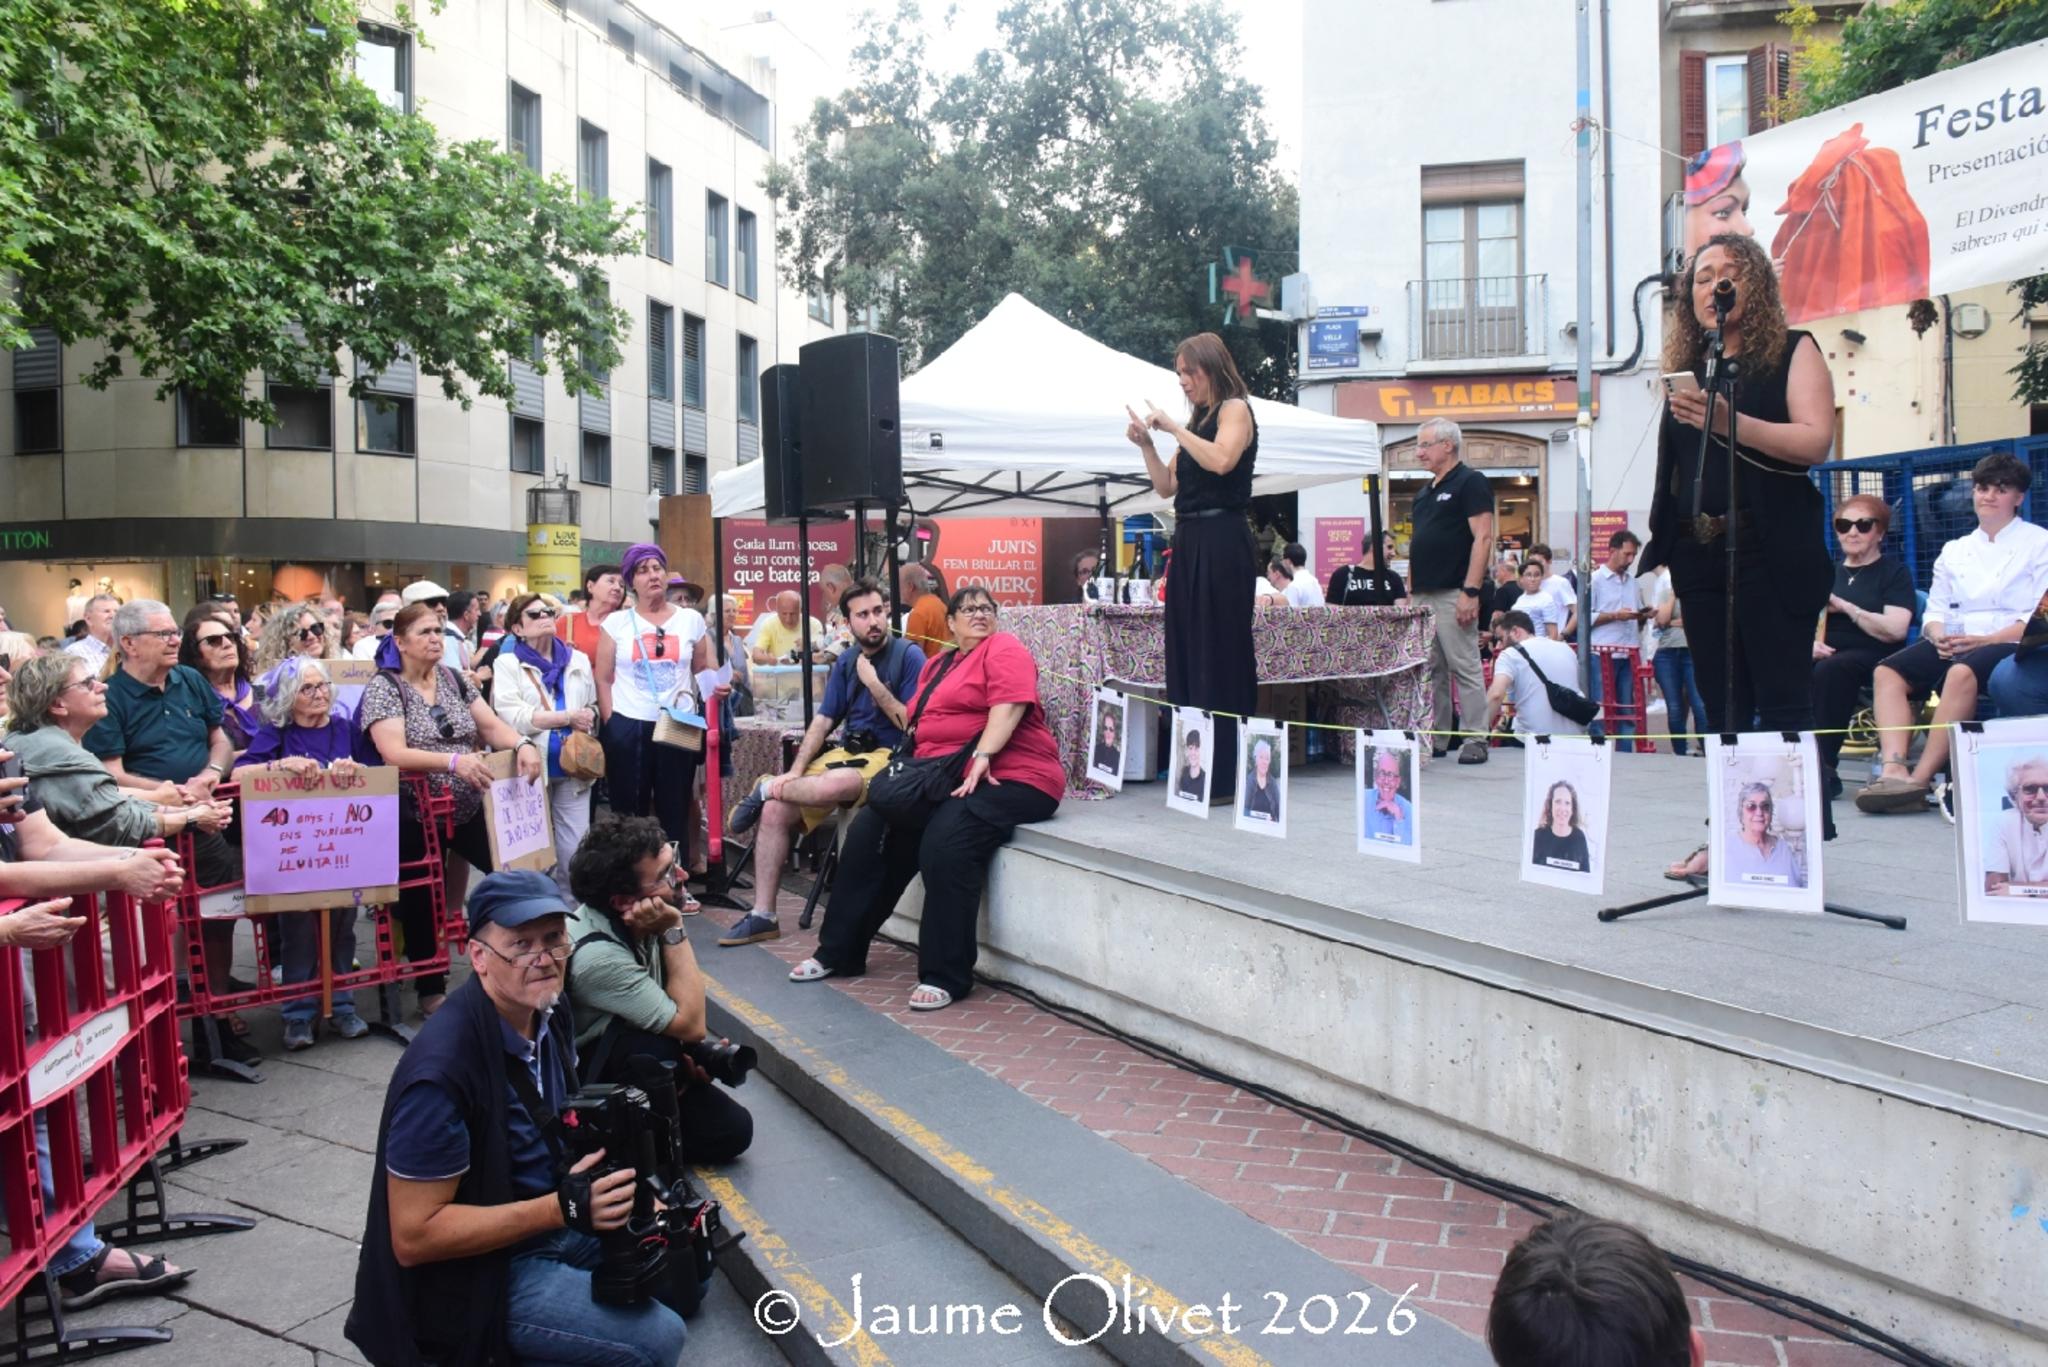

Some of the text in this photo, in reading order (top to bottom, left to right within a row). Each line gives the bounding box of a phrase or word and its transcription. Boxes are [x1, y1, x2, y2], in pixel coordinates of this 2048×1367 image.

[1912, 87, 2046, 150] Festa
[1928, 134, 2048, 184] Presentació
[1956, 211, 1973, 229] El
[1950, 230, 2008, 254] sabrem
[2012, 219, 2040, 243] qui
[1432, 381, 1555, 406] TABACS
[733, 538, 765, 550] Cada
[768, 538, 795, 550] llum
[988, 539, 1037, 554] JUNTS
[733, 552, 815, 567] és un começ
[943, 558, 1037, 570] FEM BRILLAR EL
[734, 570, 764, 586] que
[956, 575, 1037, 598] COMERÇ
[1349, 579, 1391, 591] GUES
[260, 807, 289, 827] 40
[345, 803, 373, 824] NO
[280, 832, 301, 841] ENS
[318, 842, 335, 852] LA
[569, 1199, 577, 1218] JVC
